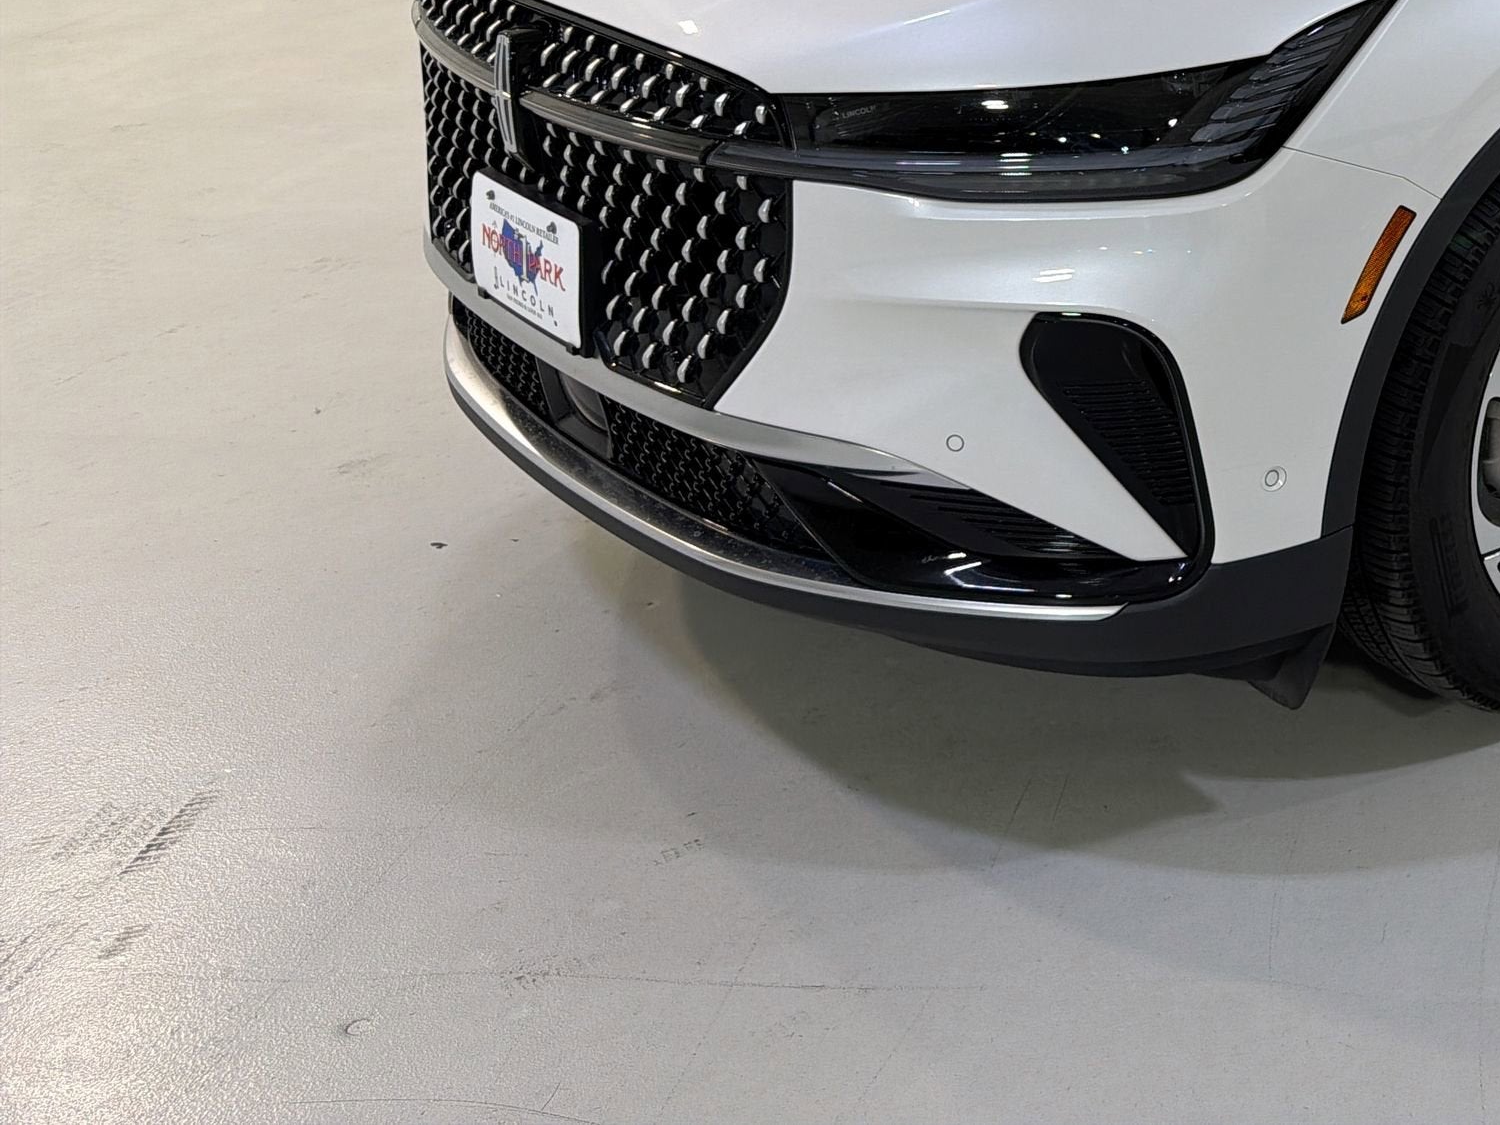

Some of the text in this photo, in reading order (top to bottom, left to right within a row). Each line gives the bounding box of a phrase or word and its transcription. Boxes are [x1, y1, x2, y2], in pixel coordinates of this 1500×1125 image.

[515, 216, 535, 233] LINCOLN
[482, 224, 566, 292] NORTH PARK
[500, 276, 554, 317] LINCOLN
